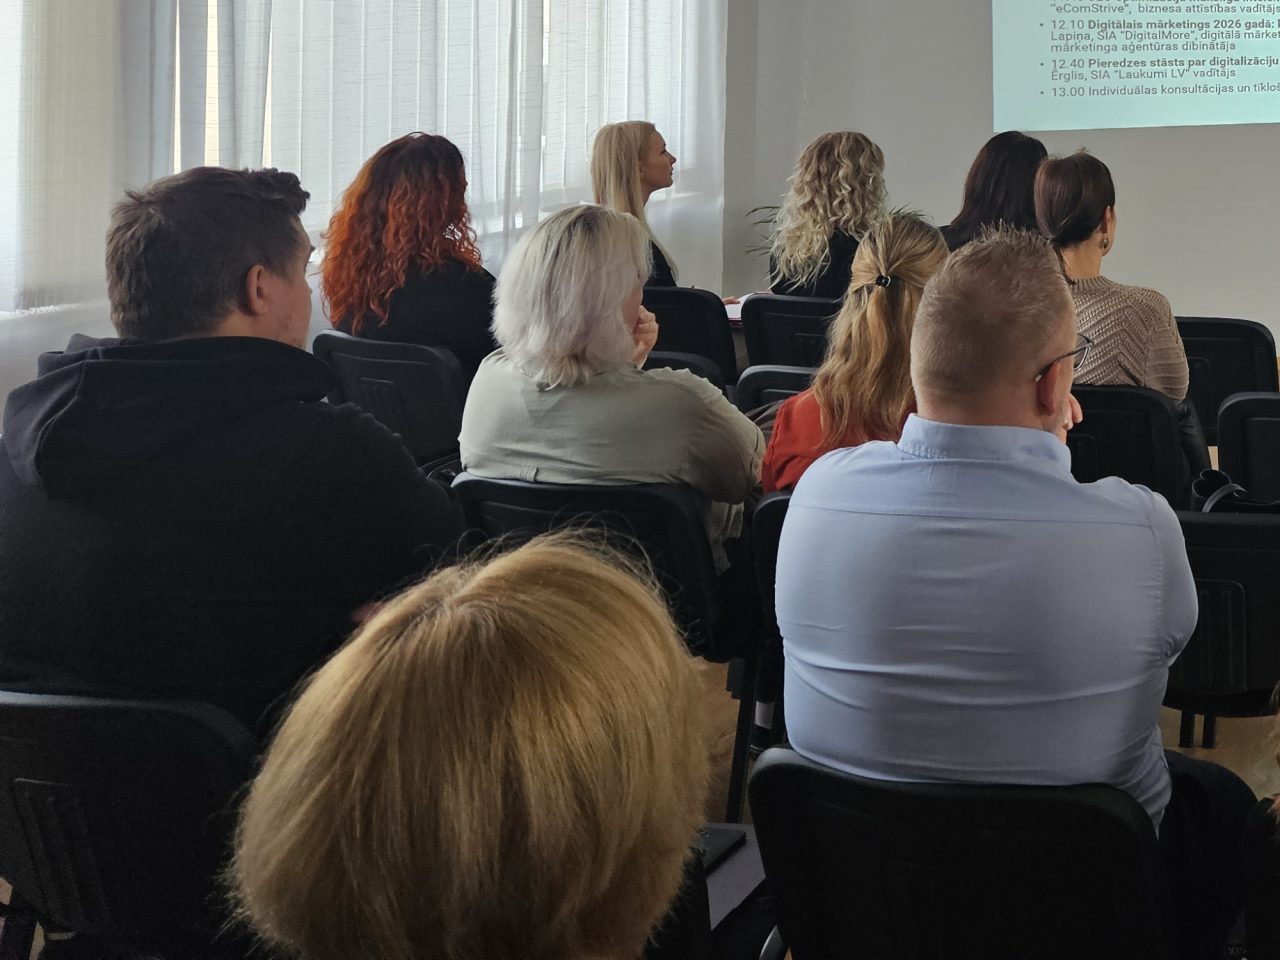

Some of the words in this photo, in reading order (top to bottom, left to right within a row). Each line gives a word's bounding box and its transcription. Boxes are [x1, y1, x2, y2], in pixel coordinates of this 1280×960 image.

[1138, 4, 1182, 13] biznesa
[1185, 4, 1237, 13] attīstības
[1051, 20, 1084, 29] 12.10
[1088, 20, 1143, 32] Digitālais
[1146, 20, 1210, 31] mārketings
[1214, 19, 1241, 28] 2026
[1245, 19, 1275, 30] gadā:
[1051, 31, 1094, 43] Lapiņa,
[1098, 30, 1117, 40] SIA
[1201, 30, 1241, 41] digitālā
[1051, 43, 1118, 54] mārketinga
[1122, 42, 1178, 53] aģentūras
[1182, 41, 1236, 52] dibinātāja
[1051, 59, 1084, 69] 12.40
[1089, 59, 1146, 68] Pieredzes
[1150, 58, 1185, 67] stāsts
[1188, 58, 1206, 69] par
[1210, 57, 1279, 67] digitalizāciju
[1051, 69, 1088, 83] Ērglis,
[1091, 70, 1110, 79] SIA
[1194, 68, 1236, 79] vadītājs
[1052, 87, 1085, 97] 13.00
[1089, 86, 1158, 96] Individuālas
[1161, 84, 1234, 95] konsultācijas
[1238, 85, 1251, 93] un
